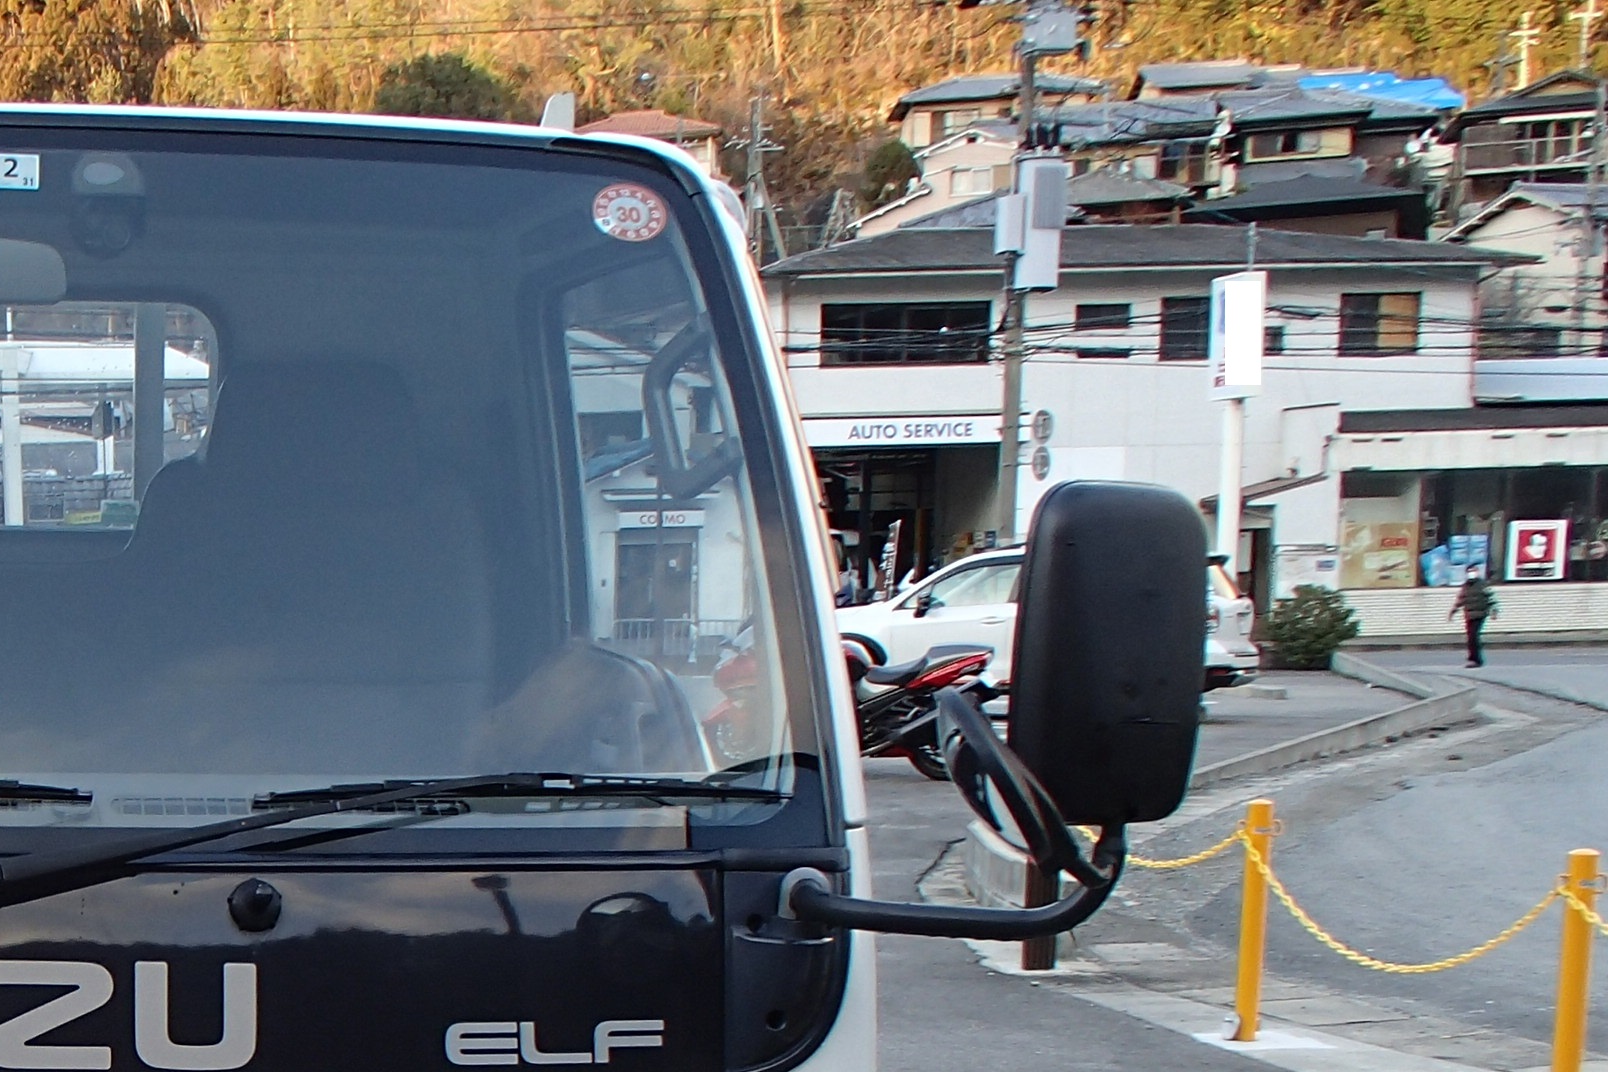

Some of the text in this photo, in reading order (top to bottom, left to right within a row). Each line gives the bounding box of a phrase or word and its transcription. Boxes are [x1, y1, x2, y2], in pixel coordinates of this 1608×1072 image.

[4, 158, 19, 178] 2
[23, 177, 34, 187] 31
[616, 206, 641, 223] 30
[848, 422, 973, 440] AUTO SERVICE
[639, 514, 686, 525] COMO
[445, 1019, 664, 1065] ELF
